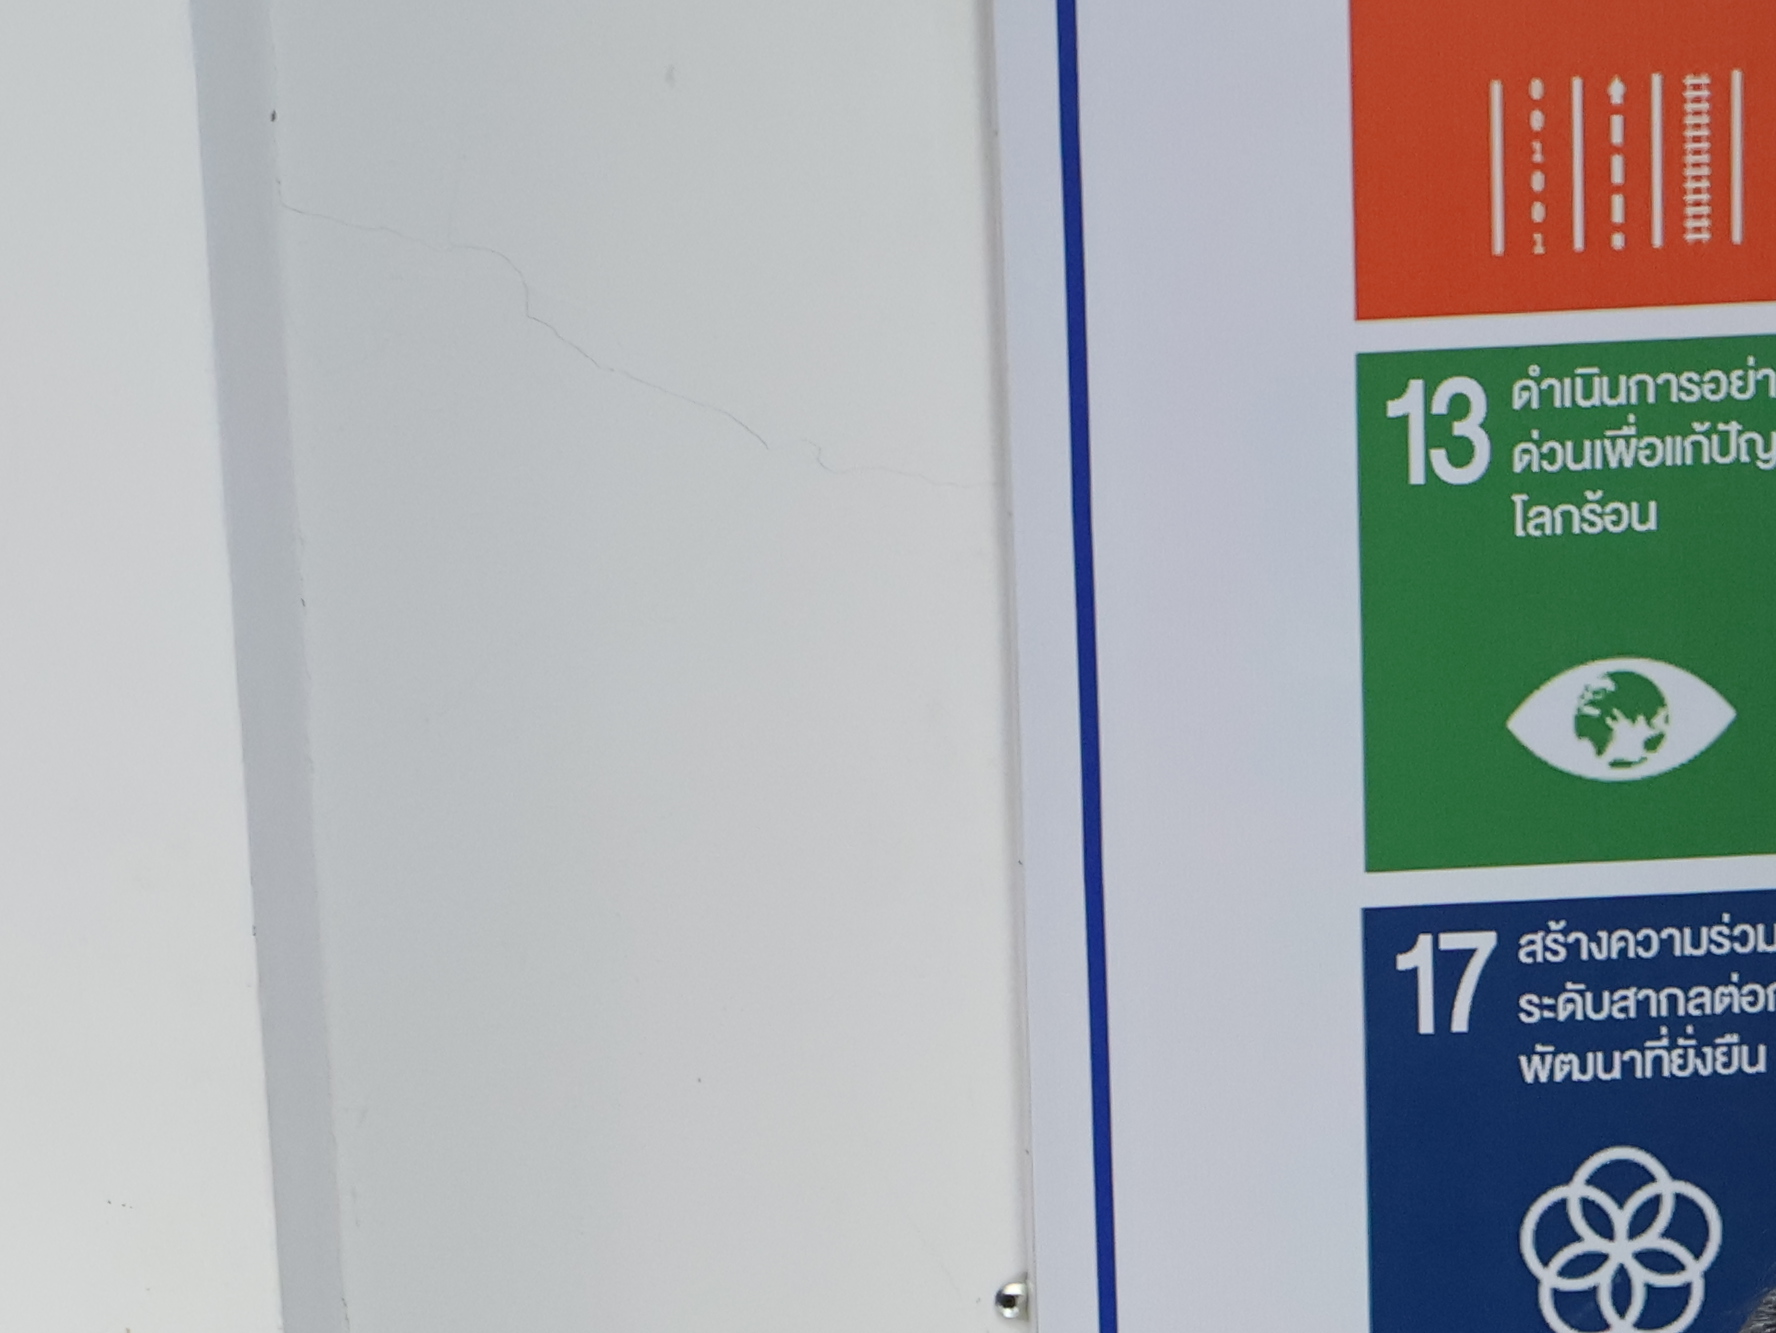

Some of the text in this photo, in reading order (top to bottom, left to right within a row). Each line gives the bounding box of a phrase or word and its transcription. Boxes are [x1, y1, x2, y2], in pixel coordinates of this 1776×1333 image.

[1386, 376, 1491, 485] 13
[1511, 490, 1658, 537] โลกร้อน
[1395, 931, 1498, 1035] 17
[1518, 1025, 1767, 1084] พัฒนาที่ยั่งยืน
